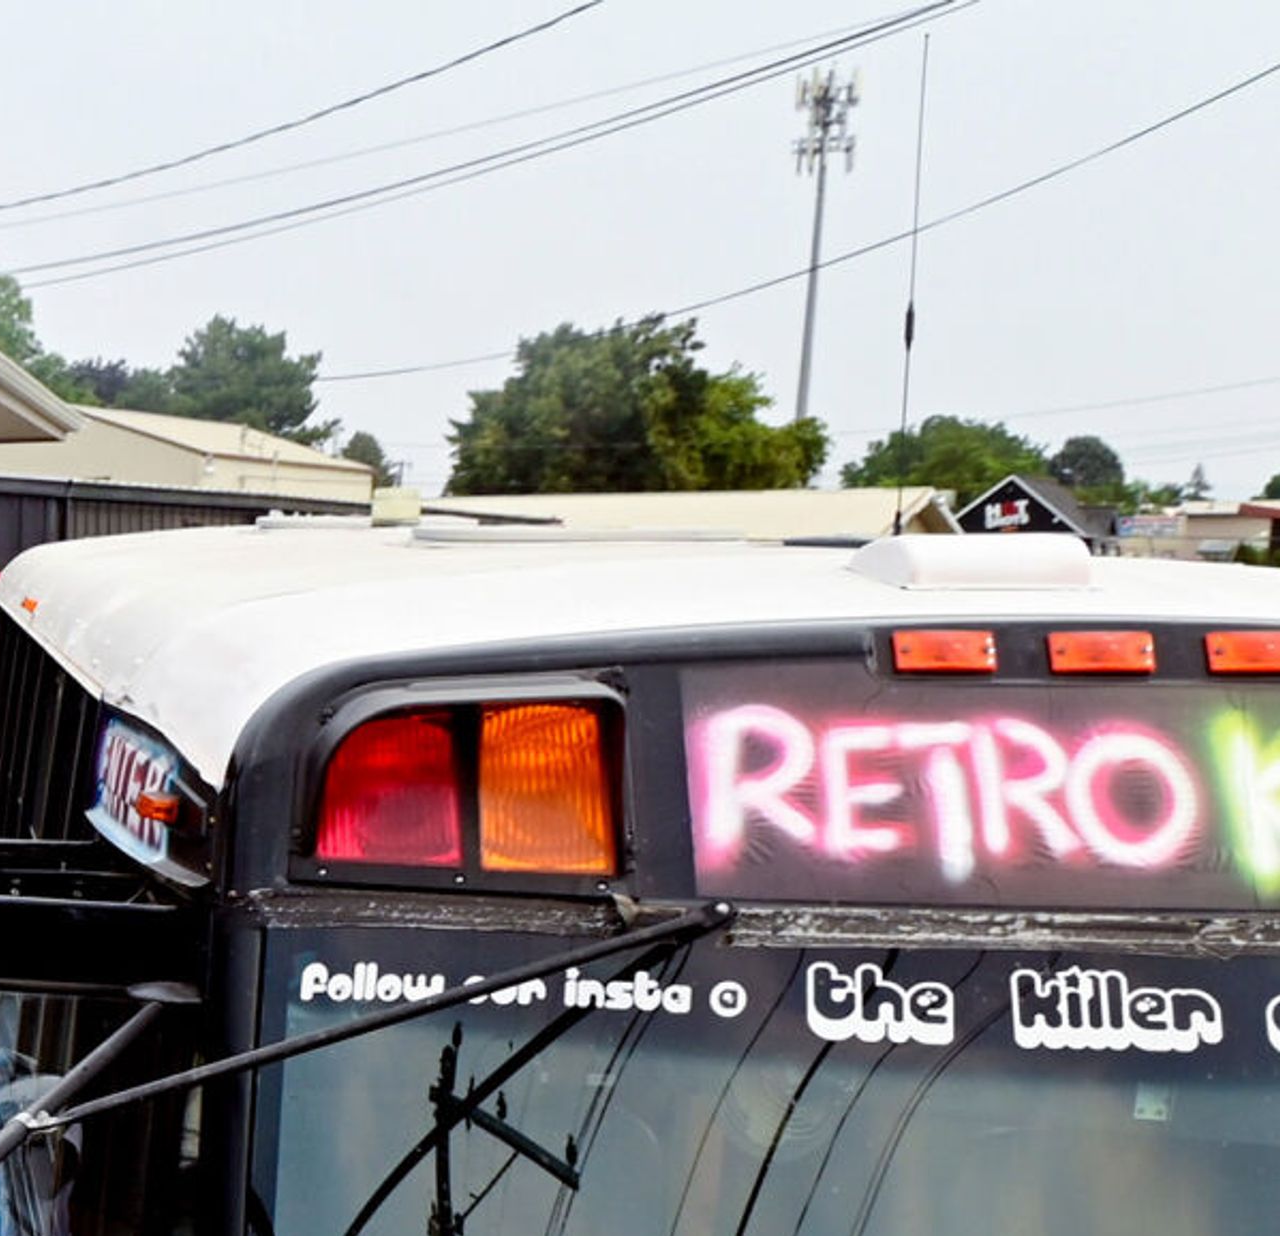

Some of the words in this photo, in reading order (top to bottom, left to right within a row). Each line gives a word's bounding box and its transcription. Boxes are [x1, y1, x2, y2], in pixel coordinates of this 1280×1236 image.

[698, 700, 1202, 884] RETRO
[299, 961, 444, 1002] follow
[563, 966, 693, 1013] insta
[807, 961, 954, 1045] the
[1010, 965, 1223, 1052] killer
